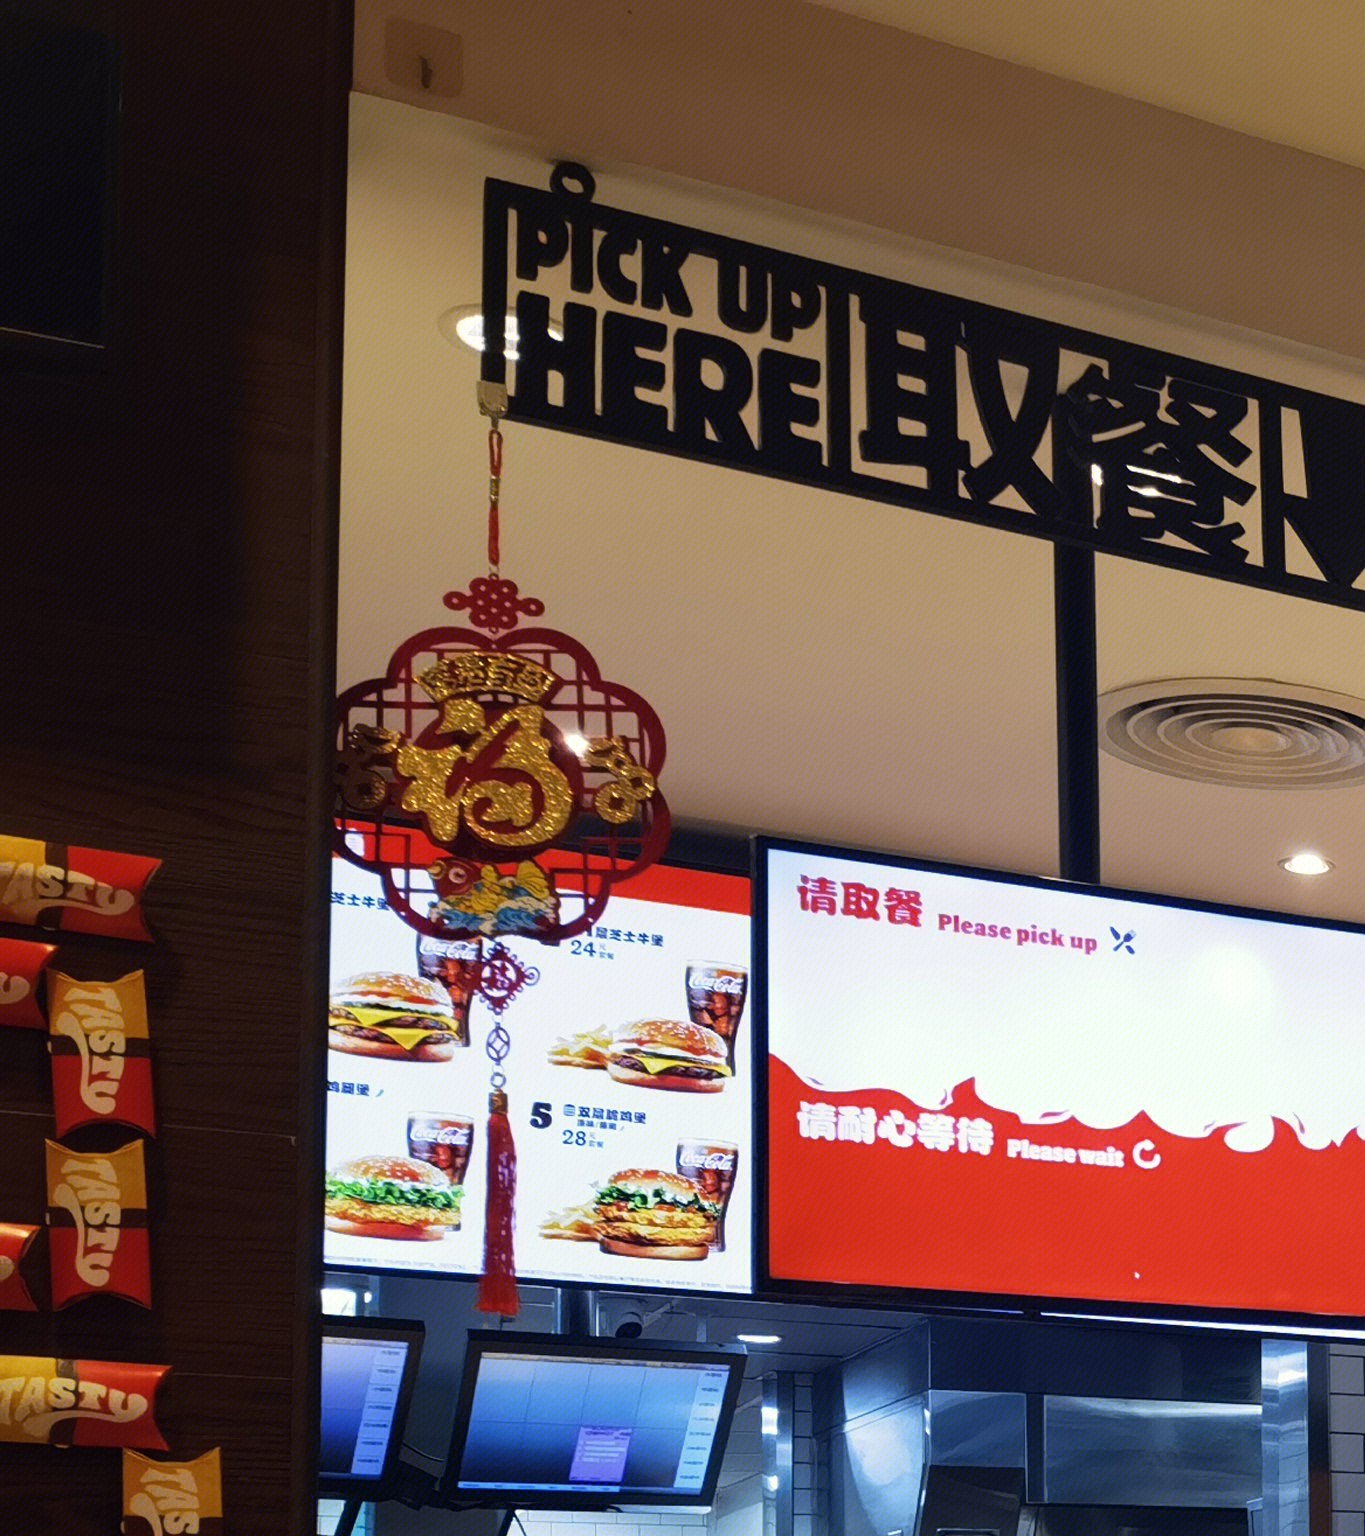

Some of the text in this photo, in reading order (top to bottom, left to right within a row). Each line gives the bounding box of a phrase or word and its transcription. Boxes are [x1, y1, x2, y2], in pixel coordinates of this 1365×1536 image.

[515, 212, 822, 343] PICK UP
[515, 290, 822, 470] HERE
[857, 292, 1256, 562] 取餐
[796, 874, 922, 927] 请取餐
[570, 940, 597, 958] 24
[586, 924, 664, 948] 层芝士牛堡
[937, 913, 1098, 955] Please pick up
[529, 1101, 553, 1129] 5
[796, 1100, 995, 1156] 请耐心等待
[562, 1129, 588, 1147] 28
[1006, 1138, 1126, 1168] Please wait
